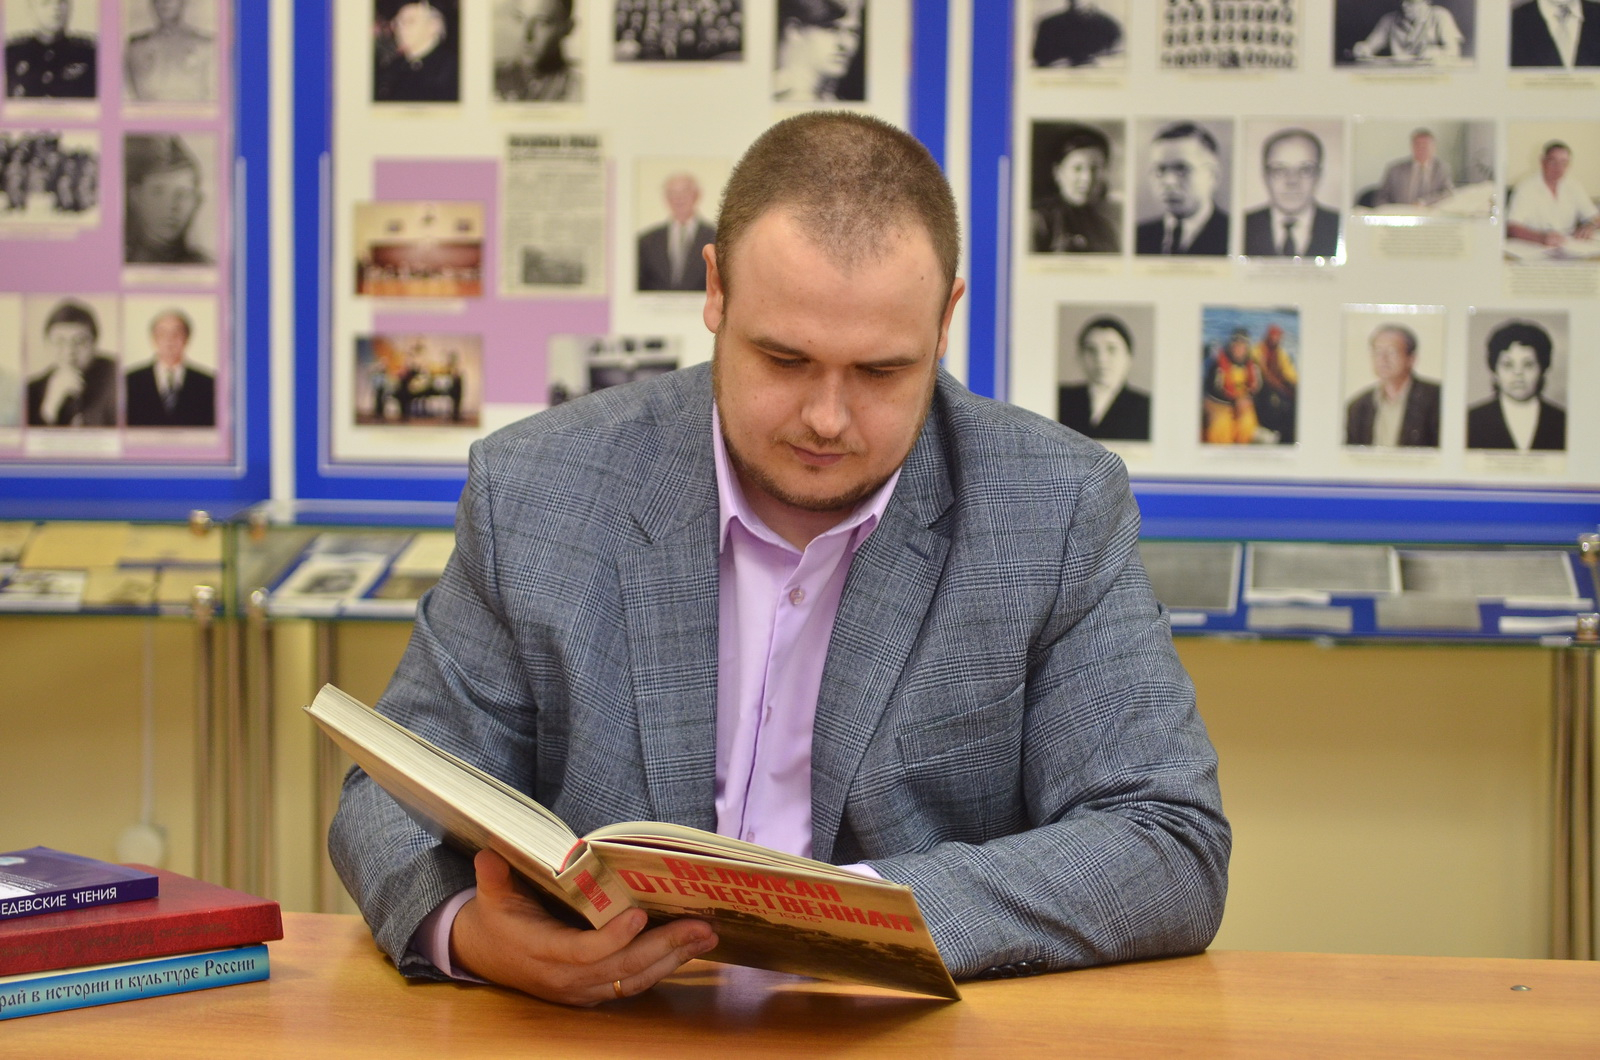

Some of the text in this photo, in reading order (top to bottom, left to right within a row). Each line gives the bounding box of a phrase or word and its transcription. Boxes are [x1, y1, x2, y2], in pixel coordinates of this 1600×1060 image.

[72, 887, 117, 904] ЧТЕНИЯ
[617, 869, 914, 933] ОТЕЧЕСТВЕННАЯ
[662, 857, 842, 903] ВЕЛИКАЯ
[32, 990, 40, 1002] в
[46, 980, 109, 1000] истории
[115, 978, 123, 990] и
[205, 959, 255, 977] России
